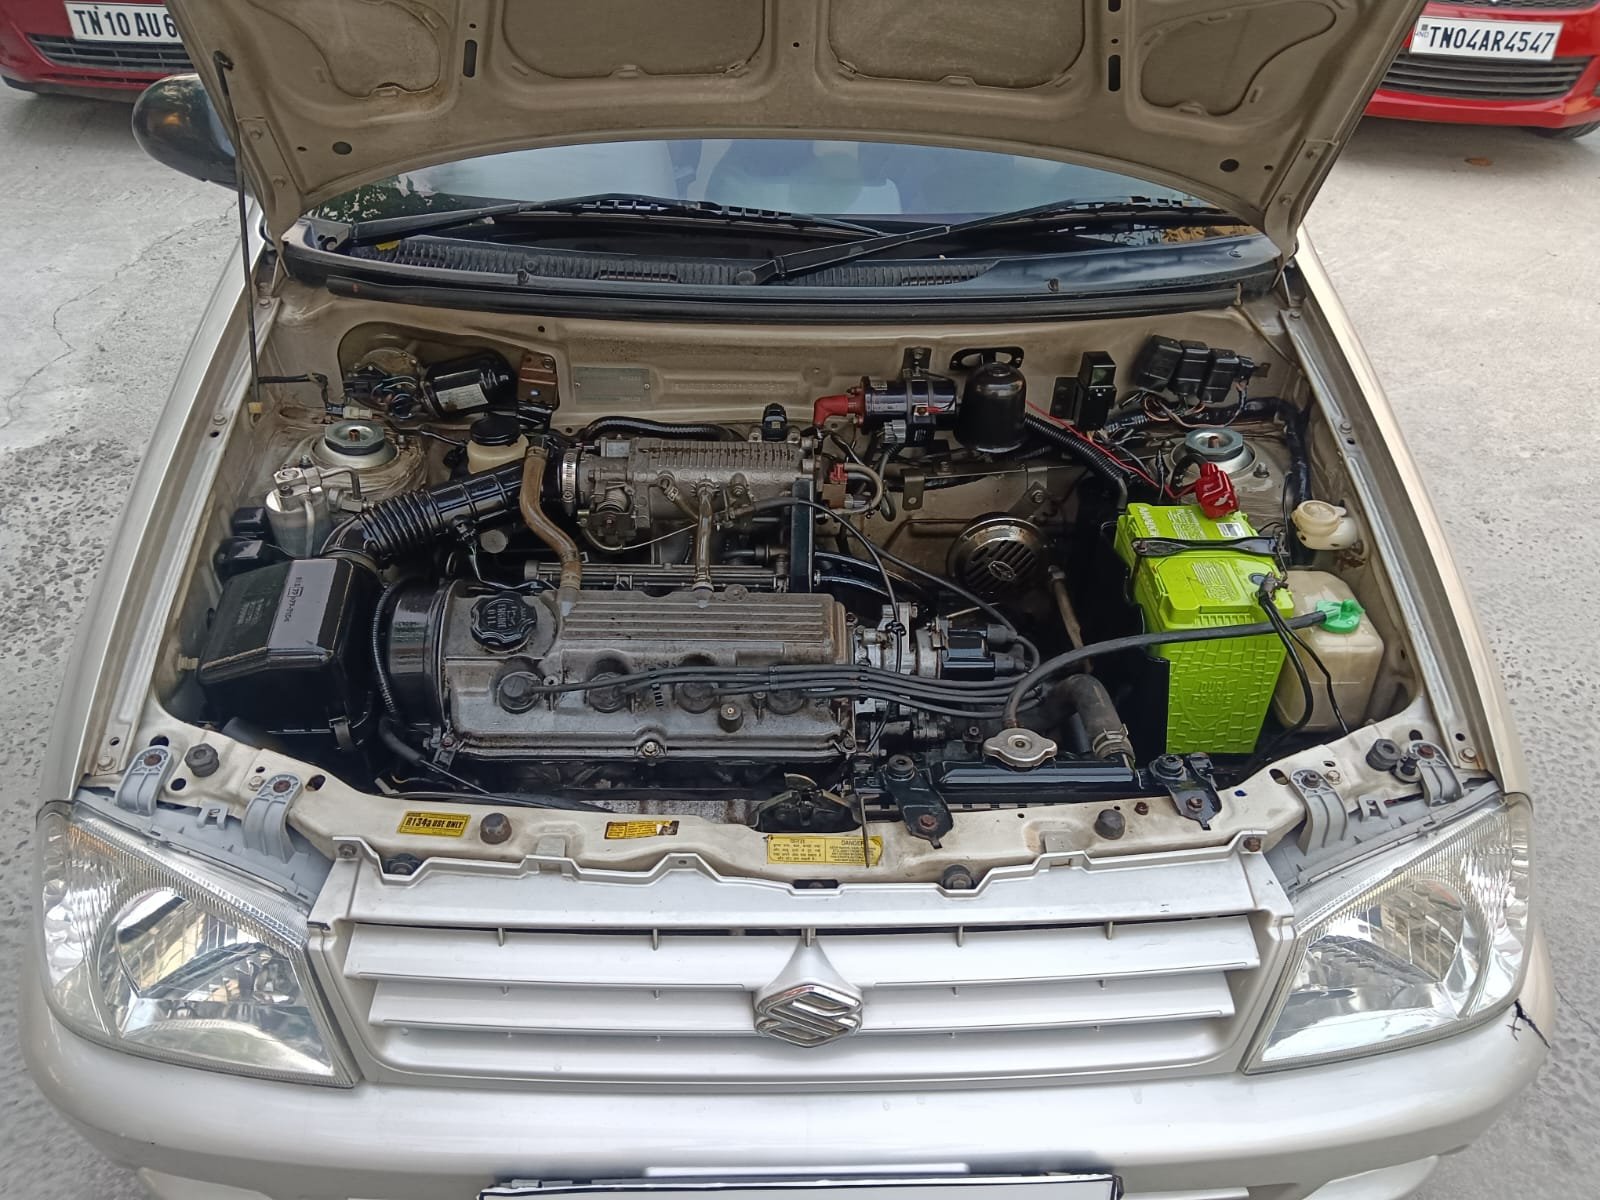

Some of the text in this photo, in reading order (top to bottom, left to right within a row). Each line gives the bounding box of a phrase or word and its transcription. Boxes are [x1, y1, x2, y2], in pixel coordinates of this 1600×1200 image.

[74, 10, 104, 36] TN
[105, 12, 131, 37] 10
[136, 13, 162, 38] AU
[1429, 26, 1555, 54] TN04AR4547
